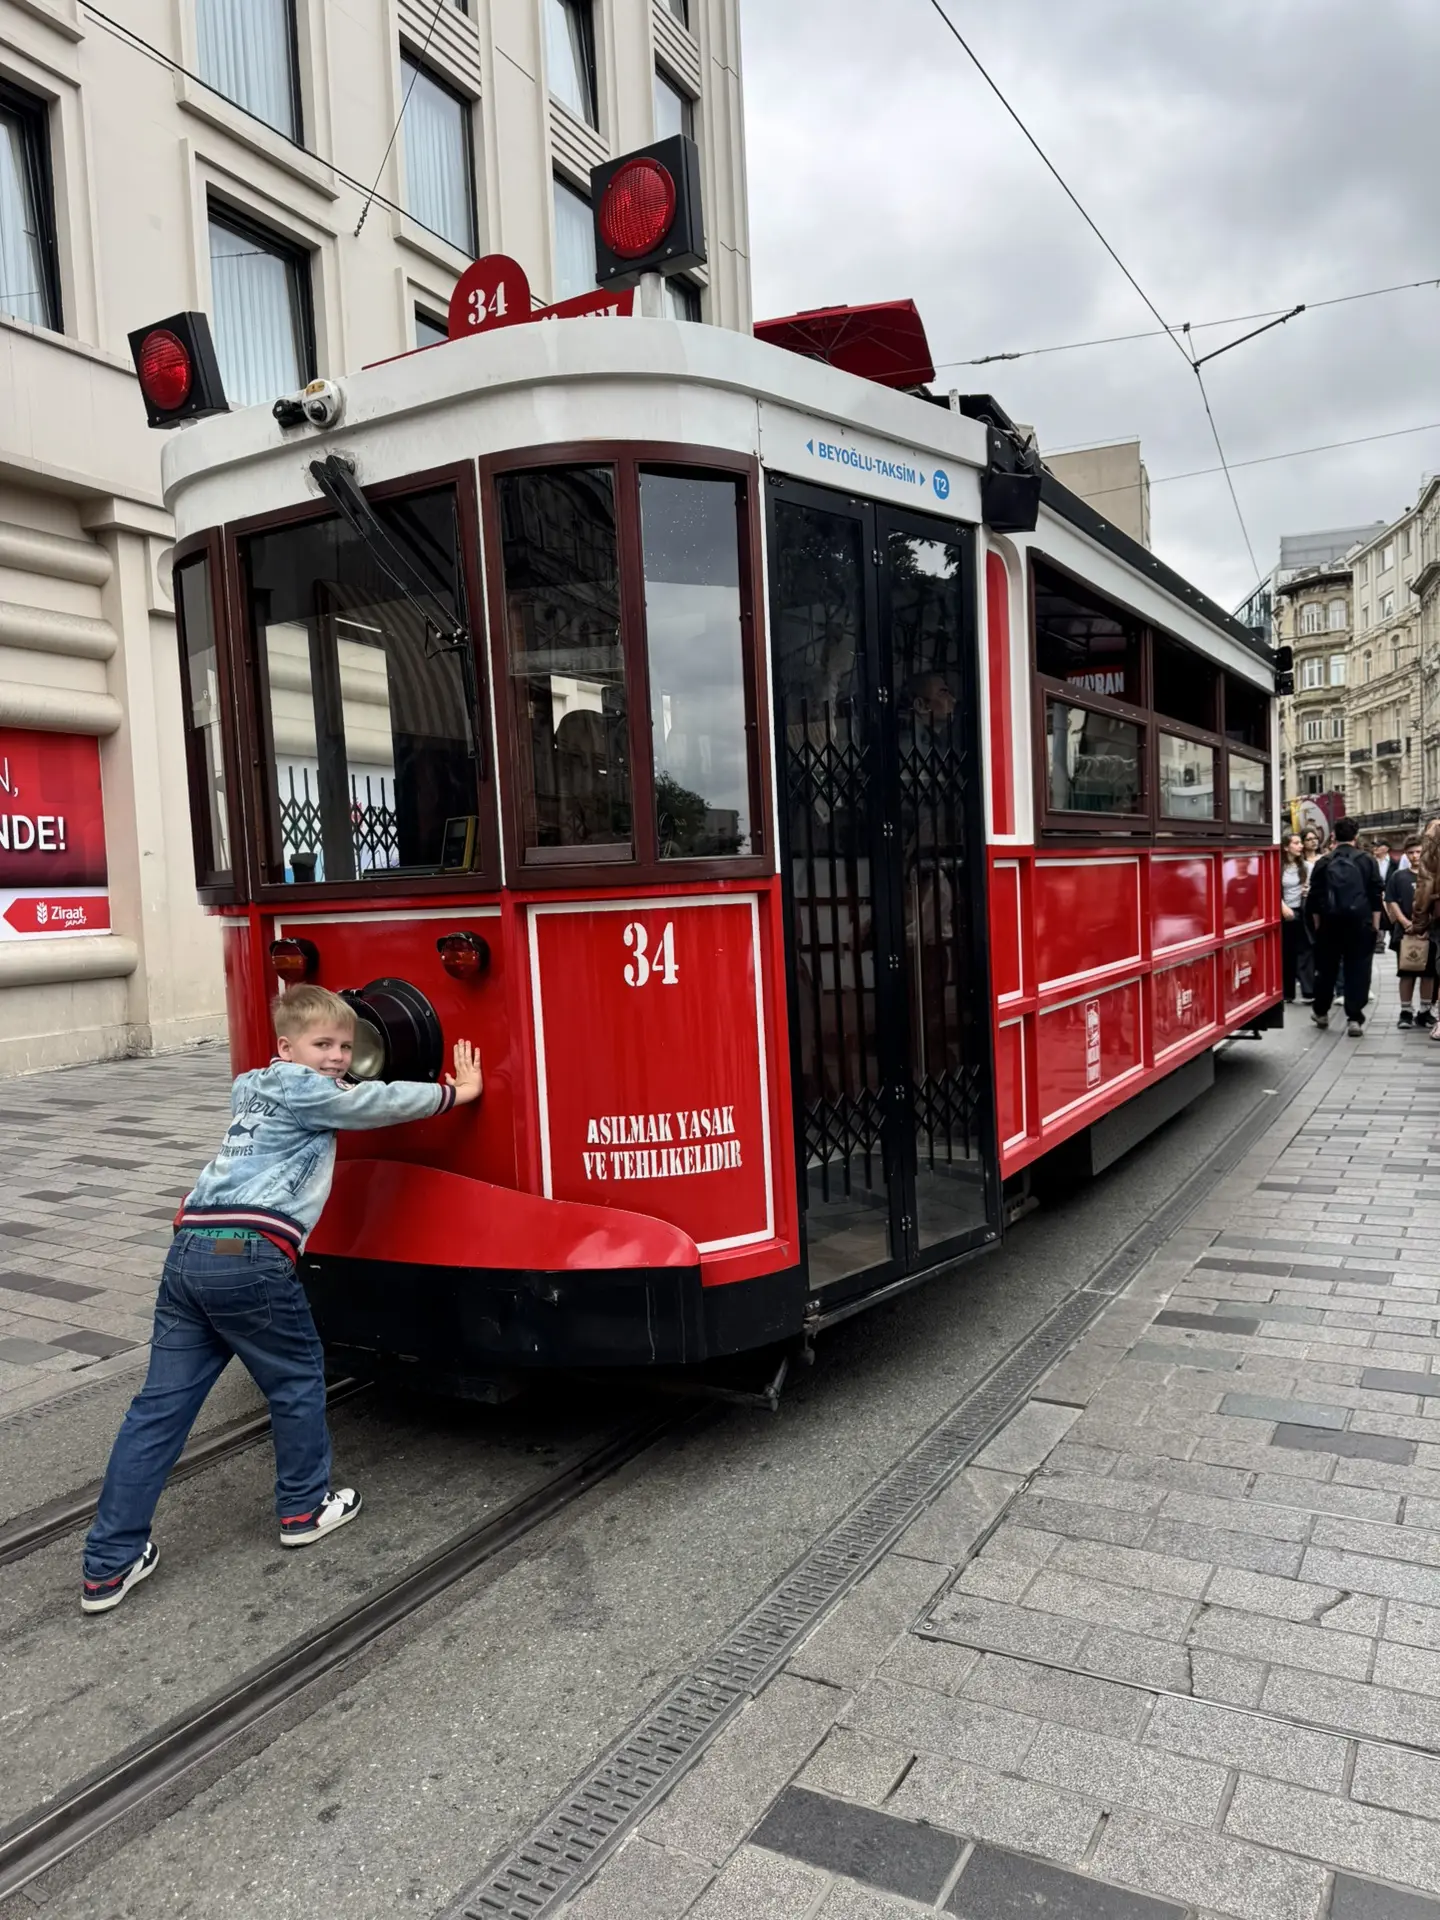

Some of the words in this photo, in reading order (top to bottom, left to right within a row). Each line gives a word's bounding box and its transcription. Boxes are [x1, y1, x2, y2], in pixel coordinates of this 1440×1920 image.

[467, 281, 508, 325] 34
[818, 442, 916, 484] BEYOĞLU-TAKSİM
[934, 476, 947, 493] T2
[51, 905, 84, 920] Ziraat
[622, 921, 679, 987] 34
[586, 1112, 674, 1145] ASILMAK
[675, 1105, 736, 1141] YASAK
[582, 1151, 609, 1180] VE
